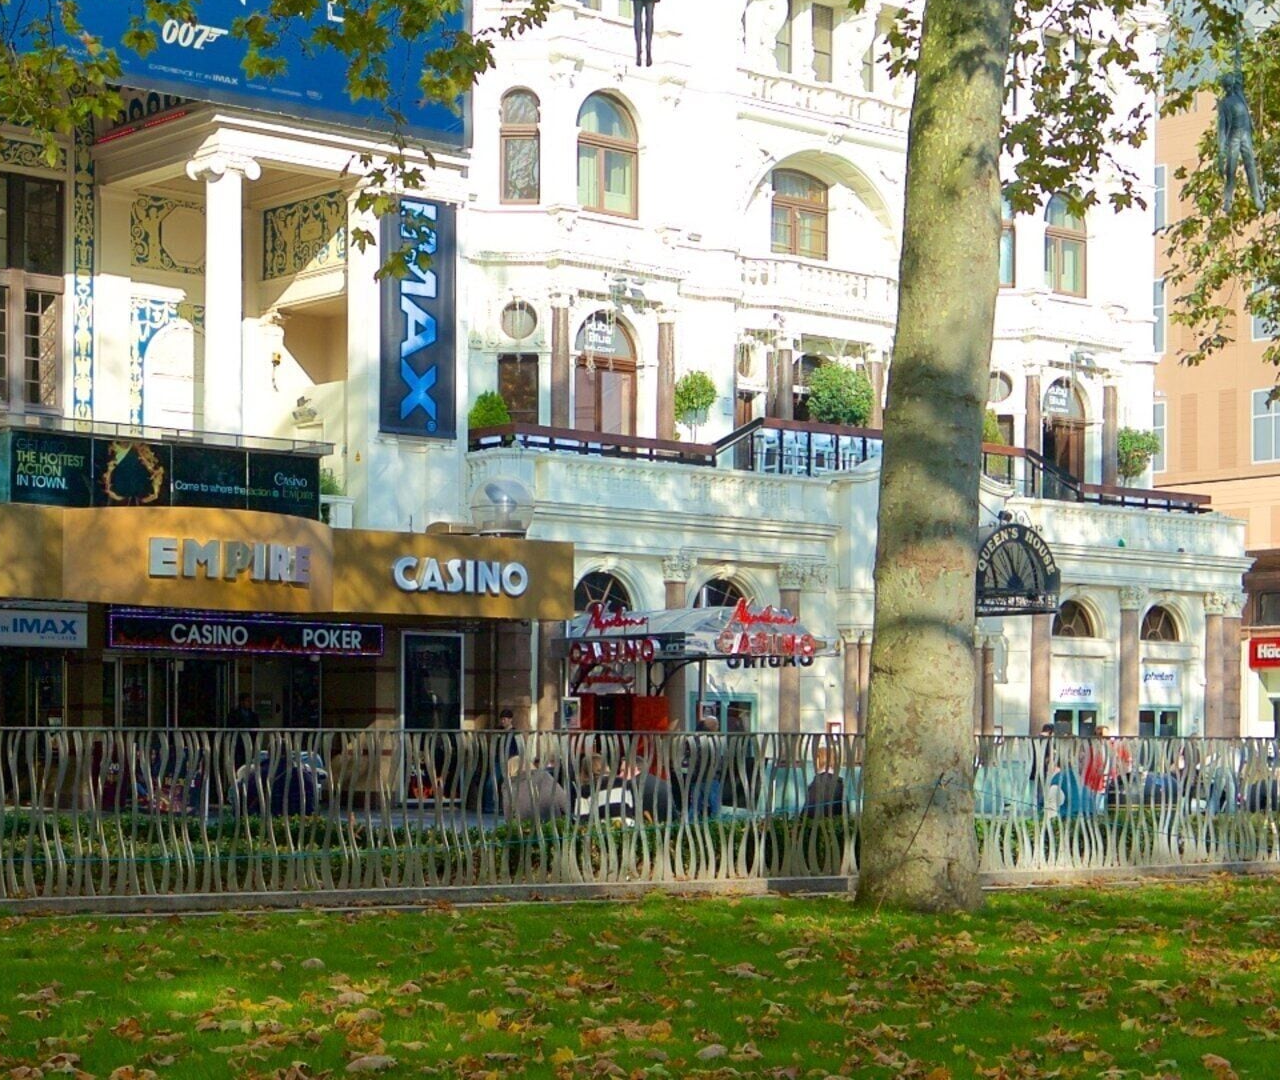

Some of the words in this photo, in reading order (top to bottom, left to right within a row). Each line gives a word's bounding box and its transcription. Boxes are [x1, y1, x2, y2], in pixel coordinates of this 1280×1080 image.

[162, 19, 228, 50] 007
[148, 63, 194, 78] EXPERIENCE
[213, 71, 239, 86] IMAX
[16, 450, 39, 464] THE
[39, 452, 85, 468] HOTTEST
[16, 463, 63, 477] ACTION
[16, 474, 30, 487] IN
[32, 476, 68, 490] TOWN.
[175, 480, 200, 493] Come
[200, 482, 209, 492] to
[148, 537, 312, 584] EMPIRE
[978, 527, 1019, 572] QUEEN'S
[1024, 530, 1056, 575] HOUSE
[393, 556, 528, 597] CASINO
[0, 625, 9, 633] IN
[12, 617, 78, 636] IMAX
[170, 623, 249, 646] CASINO
[302, 628, 362, 649] POKER
[719, 631, 817, 656] CASINO
[1144, 671, 1174, 683] phelan
[1059, 685, 1092, 698] phelan
